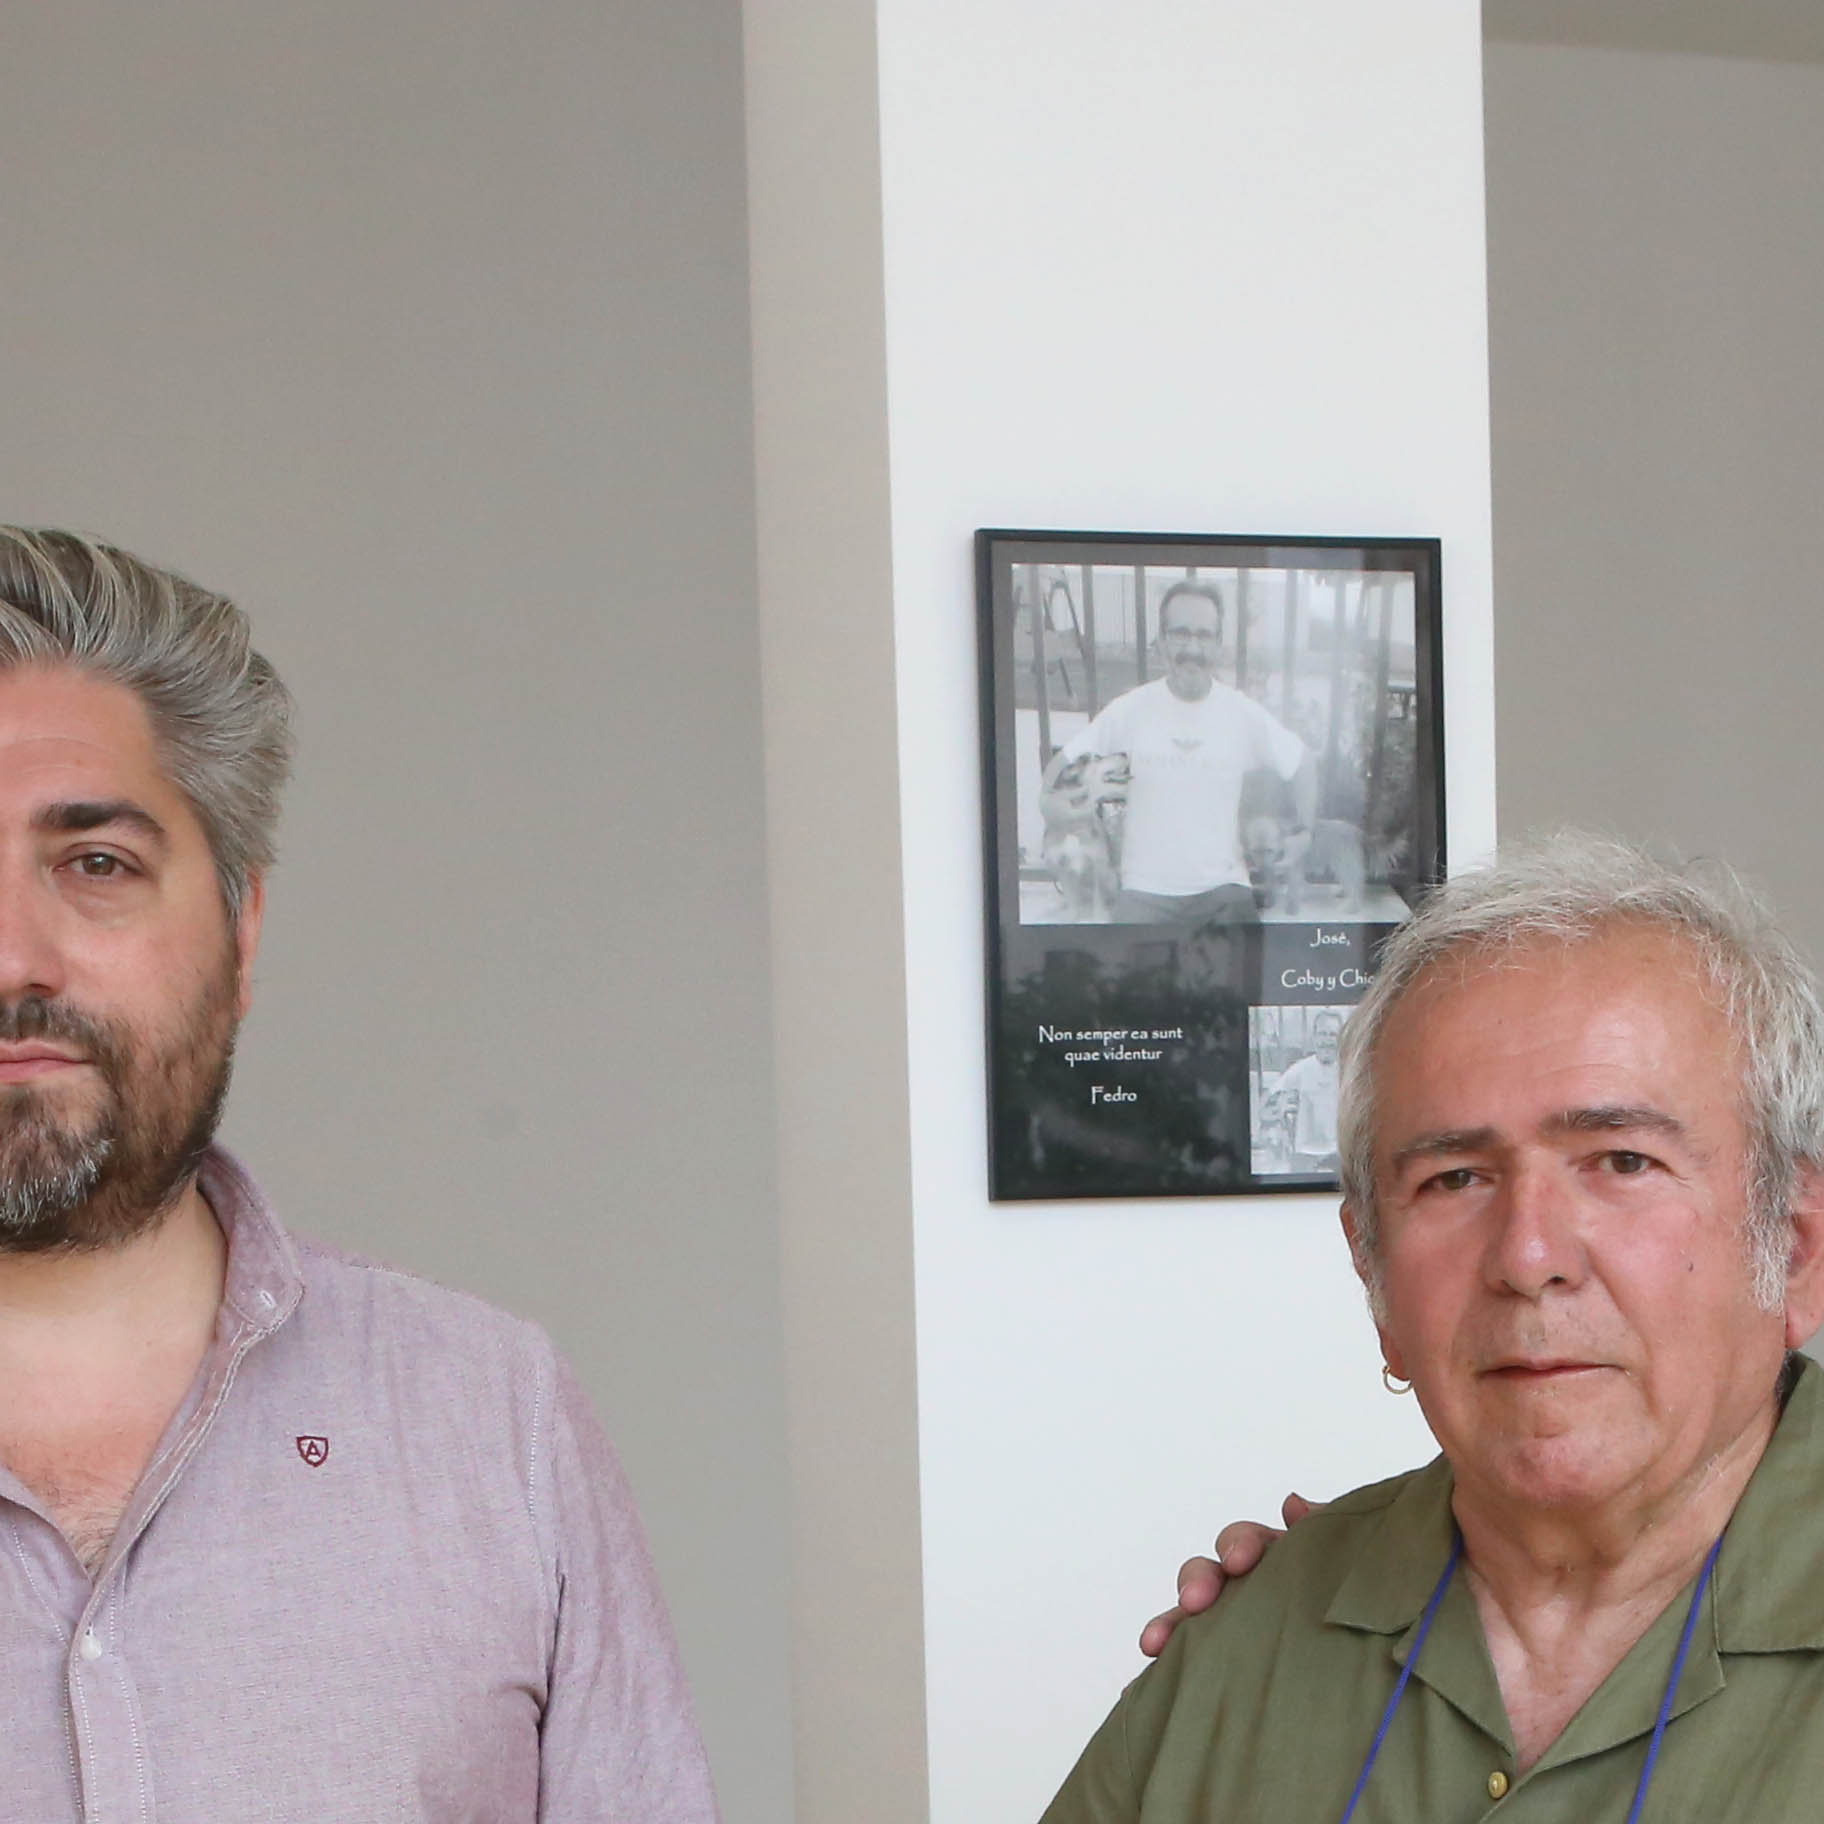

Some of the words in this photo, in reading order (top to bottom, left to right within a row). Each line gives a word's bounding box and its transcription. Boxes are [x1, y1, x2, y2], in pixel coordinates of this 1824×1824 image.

[1309, 928, 1351, 947] José,
[1281, 969, 1324, 991] Coby
[1327, 976, 1336, 991] y
[1038, 1025, 1073, 1043] Non
[1076, 1029, 1128, 1046] semper
[1130, 1030, 1148, 1040] ea
[1151, 1027, 1184, 1040] sunt
[1064, 1050, 1100, 1067] quae
[1103, 1044, 1163, 1061] videntur
[1091, 1085, 1137, 1104] Fedro
